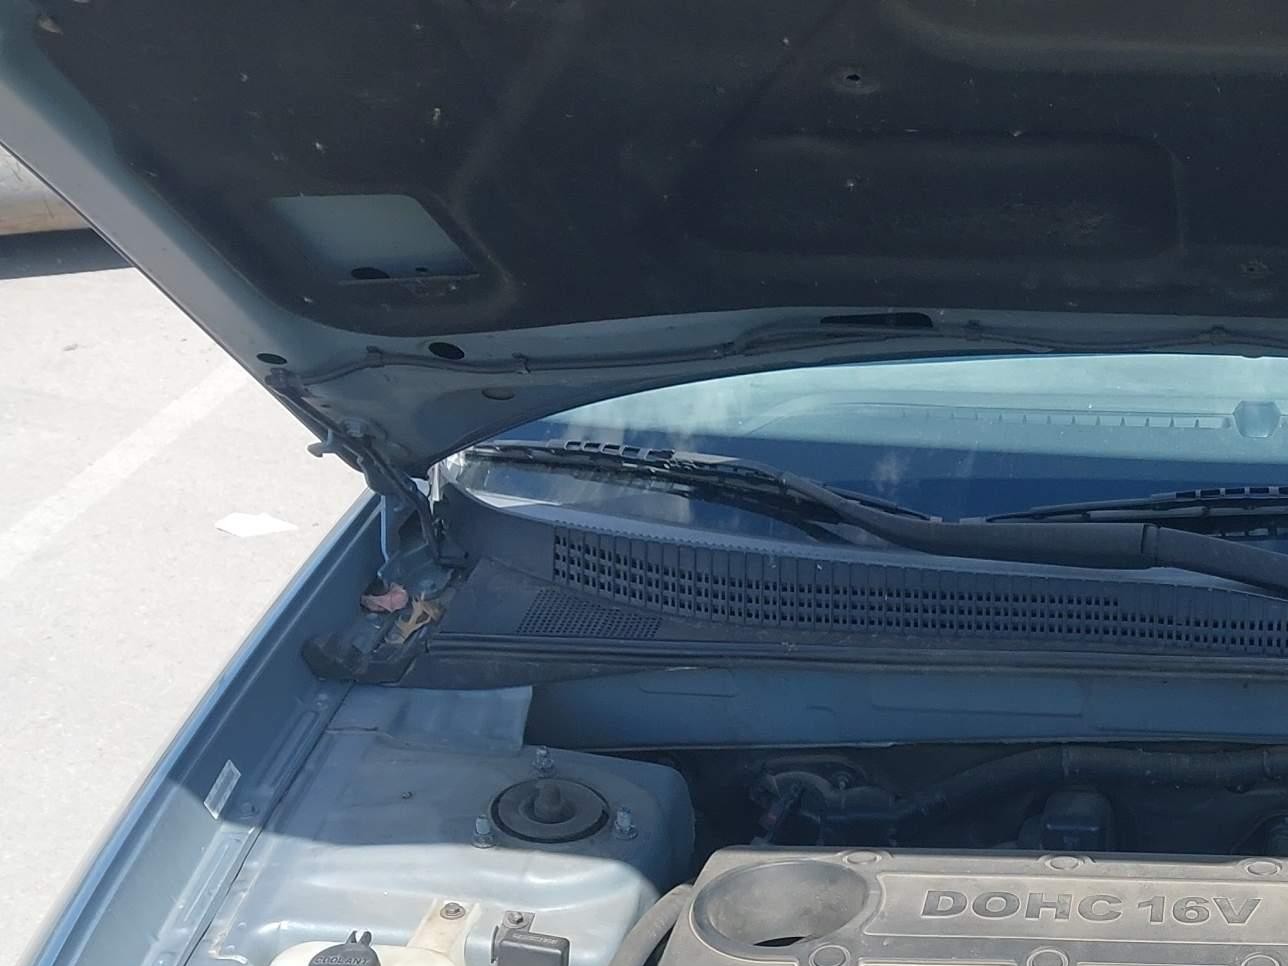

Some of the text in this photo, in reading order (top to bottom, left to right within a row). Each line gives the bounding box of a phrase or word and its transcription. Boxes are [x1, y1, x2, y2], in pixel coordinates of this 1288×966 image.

[921, 889, 1264, 927] DOHC 16V
[313, 953, 370, 966] COOLANT
